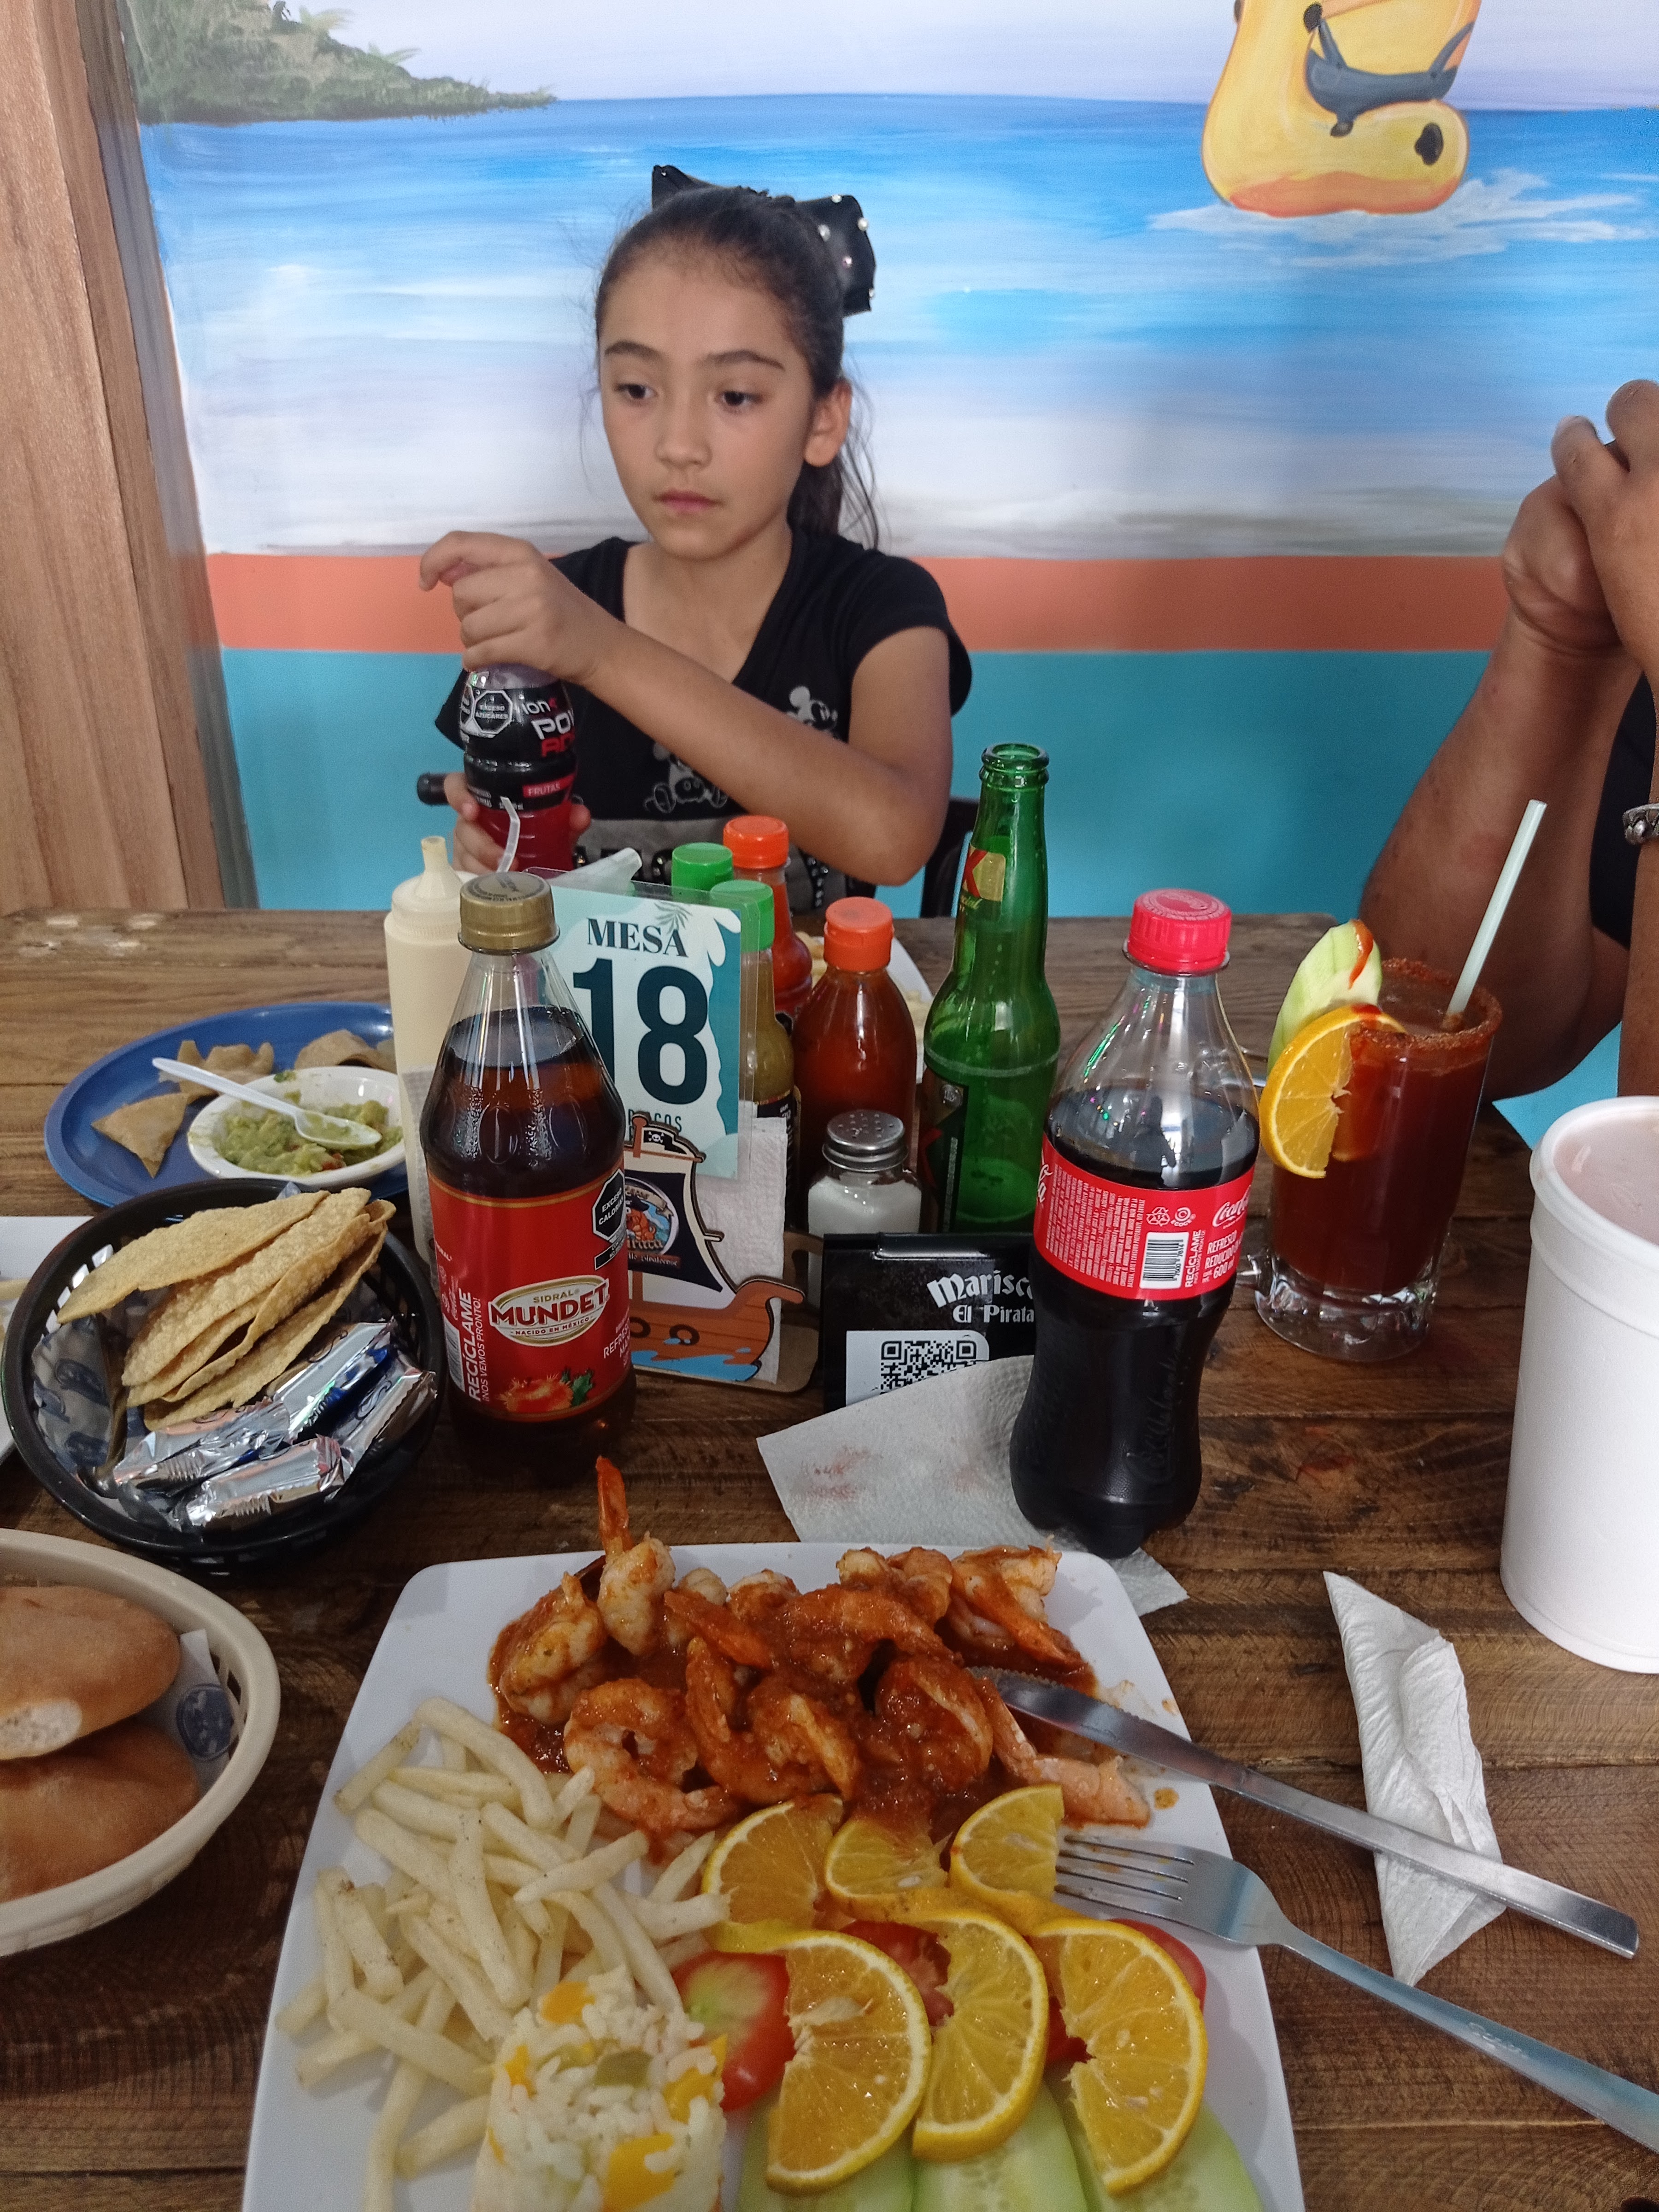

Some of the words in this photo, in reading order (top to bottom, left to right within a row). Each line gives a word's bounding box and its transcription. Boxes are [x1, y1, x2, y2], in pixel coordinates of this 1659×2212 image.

[528, 782, 560, 796] FRUTAS
[587, 918, 688, 958] MESA
[573, 958, 708, 1105] 18
[1185, 1229, 1202, 1288] RECÍCLAME
[490, 1282, 607, 1325] MUNDET
[533, 1291, 573, 1303] SIDRAL
[953, 1304, 972, 1323] El
[983, 1304, 1035, 1323] Pirata
[471, 1297, 484, 1341] PRONTO!
[562, 1317, 589, 1331] MÉXICO
[459, 1288, 481, 1401] RECÍCLAME
[477, 1343, 488, 1377] VEMOS
